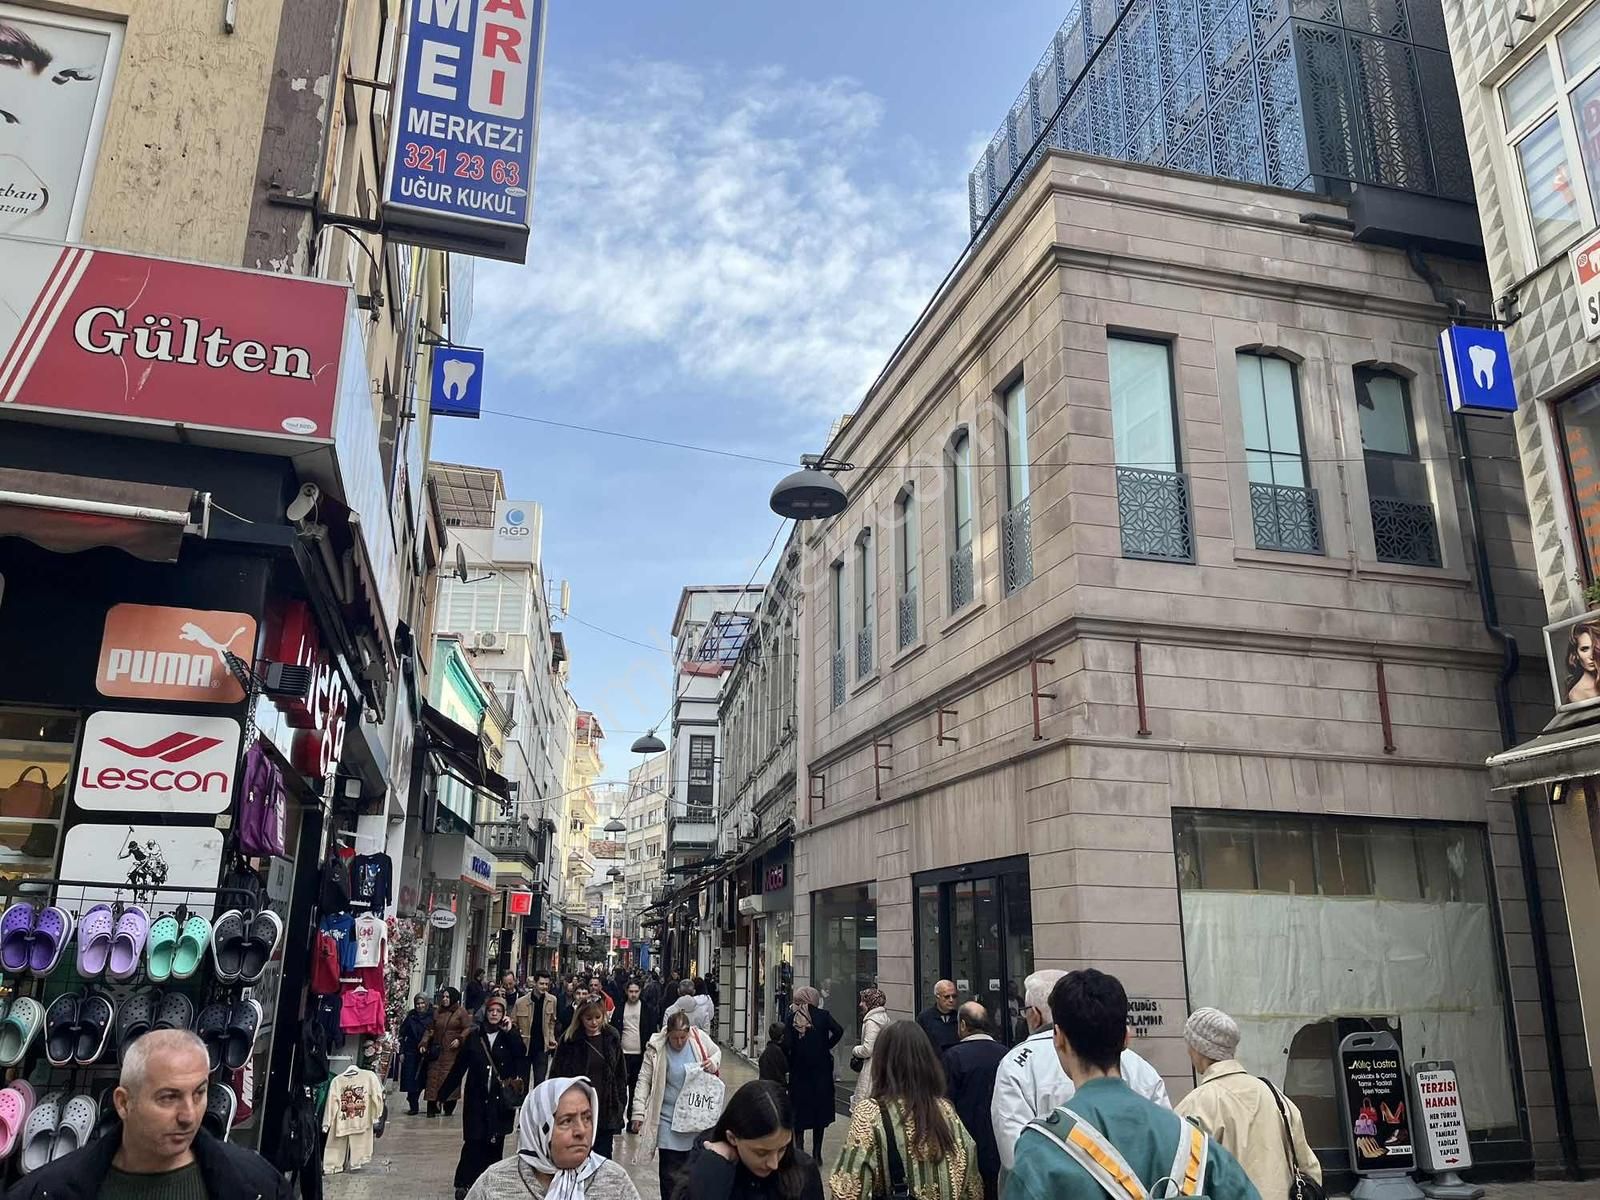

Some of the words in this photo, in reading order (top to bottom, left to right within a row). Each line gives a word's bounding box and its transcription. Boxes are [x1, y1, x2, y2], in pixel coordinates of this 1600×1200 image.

[404, 143, 447, 174] 321
[454, 153, 485, 181] 23
[491, 160, 520, 187] 63
[400, 175, 452, 204] UĞUR
[457, 187, 516, 215] KUKUL
[73, 305, 314, 380] Gülten
[499, 526, 530, 536] AGD
[106, 648, 214, 687] PUMA
[1126, 1014, 1164, 1026] SLAMDIR
[1373, 1059, 1397, 1069] Lostra
[1420, 1074, 1438, 1082] Bayan
[1420, 1079, 1457, 1094] TERZİSİ
[688, 1092, 715, 1110] U&ME
[1425, 1096, 1457, 1109] HAKAN
[1443, 1120, 1461, 1128] BAYAN
